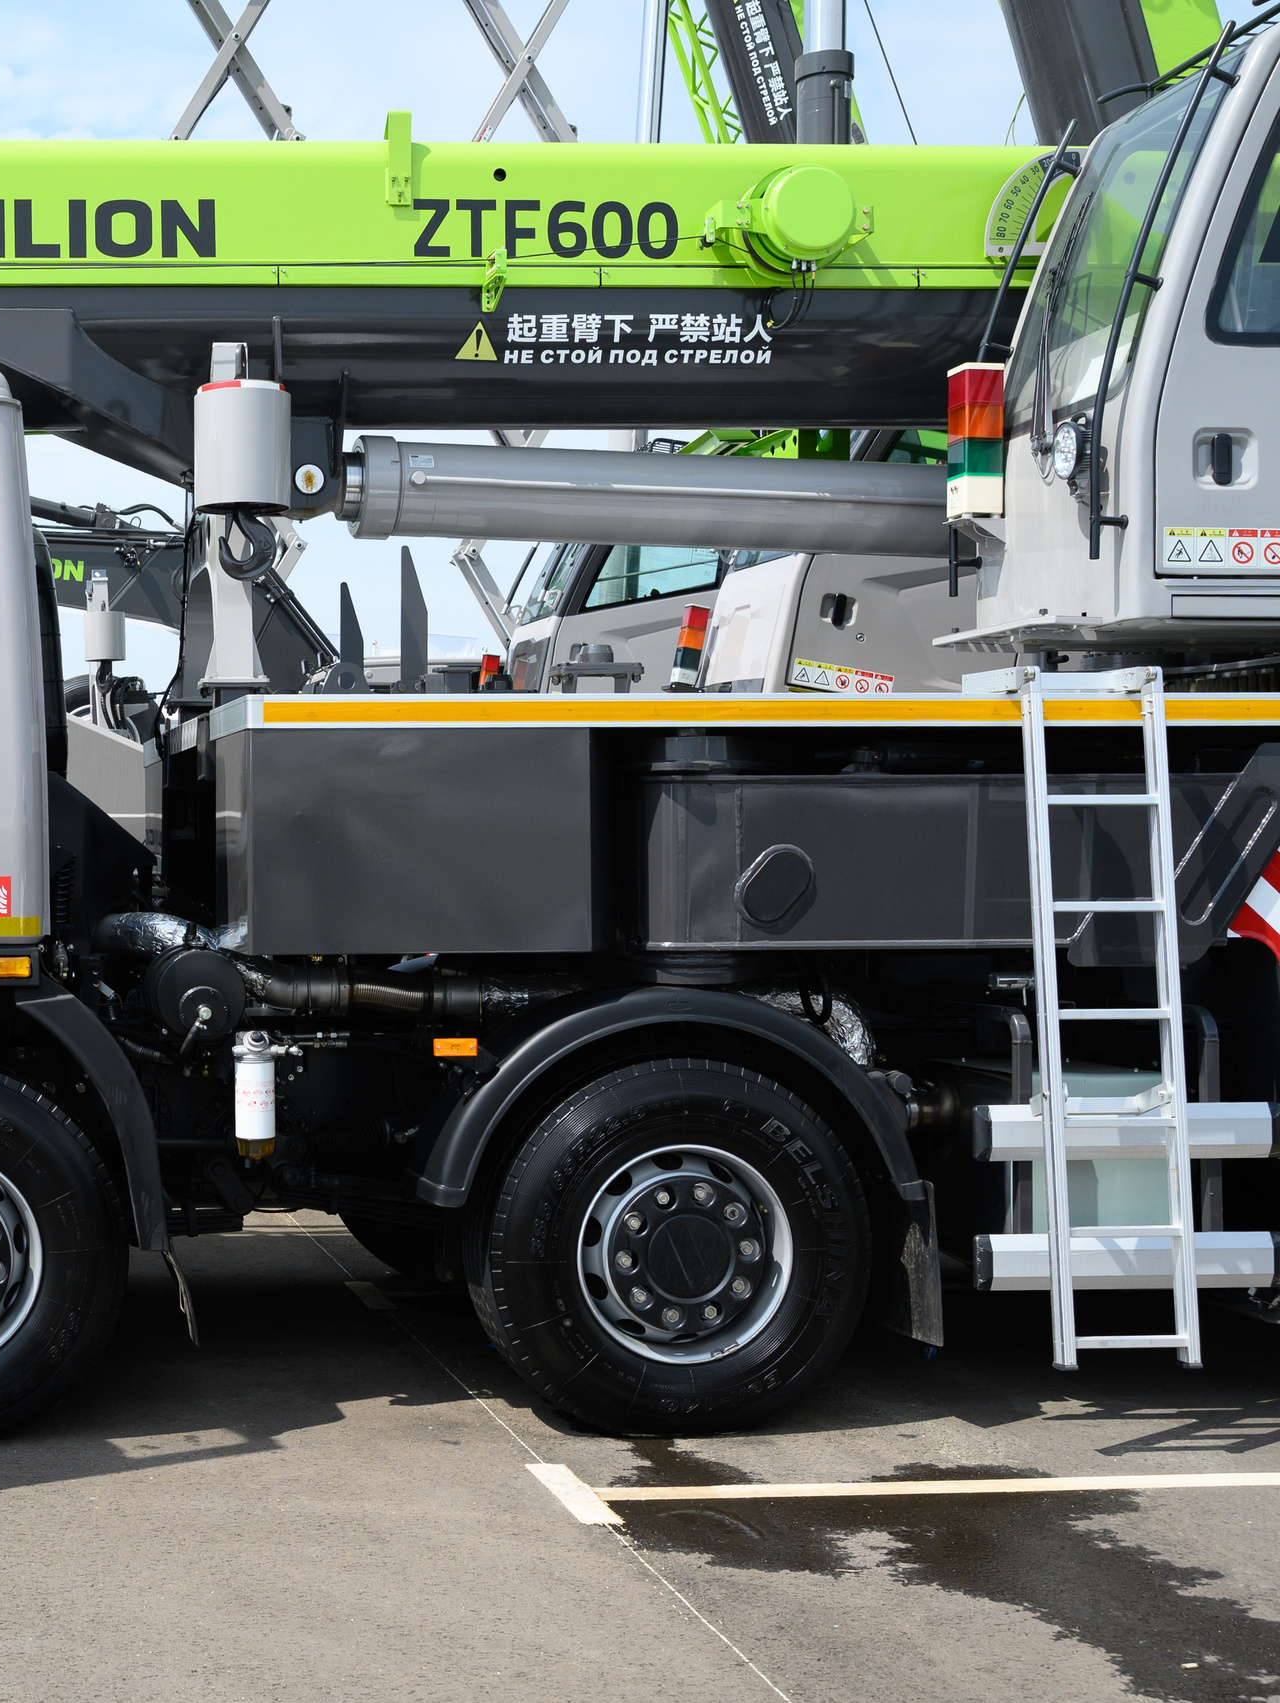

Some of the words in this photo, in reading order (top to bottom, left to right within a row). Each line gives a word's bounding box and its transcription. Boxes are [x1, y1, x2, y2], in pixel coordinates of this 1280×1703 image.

[734, 5, 745, 21] НЕ
[739, 21, 756, 51] СТОЙ
[749, 49, 762, 77] ПОД
[756, 76, 778, 126] СТРЕЛОЙ
[764, 60, 792, 121] 严禁站人
[1019, 175, 1030, 185] 40
[1029, 165, 1040, 175] 30
[1010, 185, 1021, 197] 50
[1003, 198, 1014, 210] 60
[413, 198, 679, 259] ZTF600
[998, 212, 1010, 224] 70
[996, 226, 1007, 238] 80
[506, 313, 634, 343] 起重臂下
[648, 313, 773, 343] 严禁站人
[503, 349, 534, 364] НЕ
[540, 347, 603, 364] СТОЙ
[608, 349, 658, 366] ПОД
[664, 345, 772, 364] СТРЕЛОЙ
[759, 1116, 848, 1317] BELSHINA
